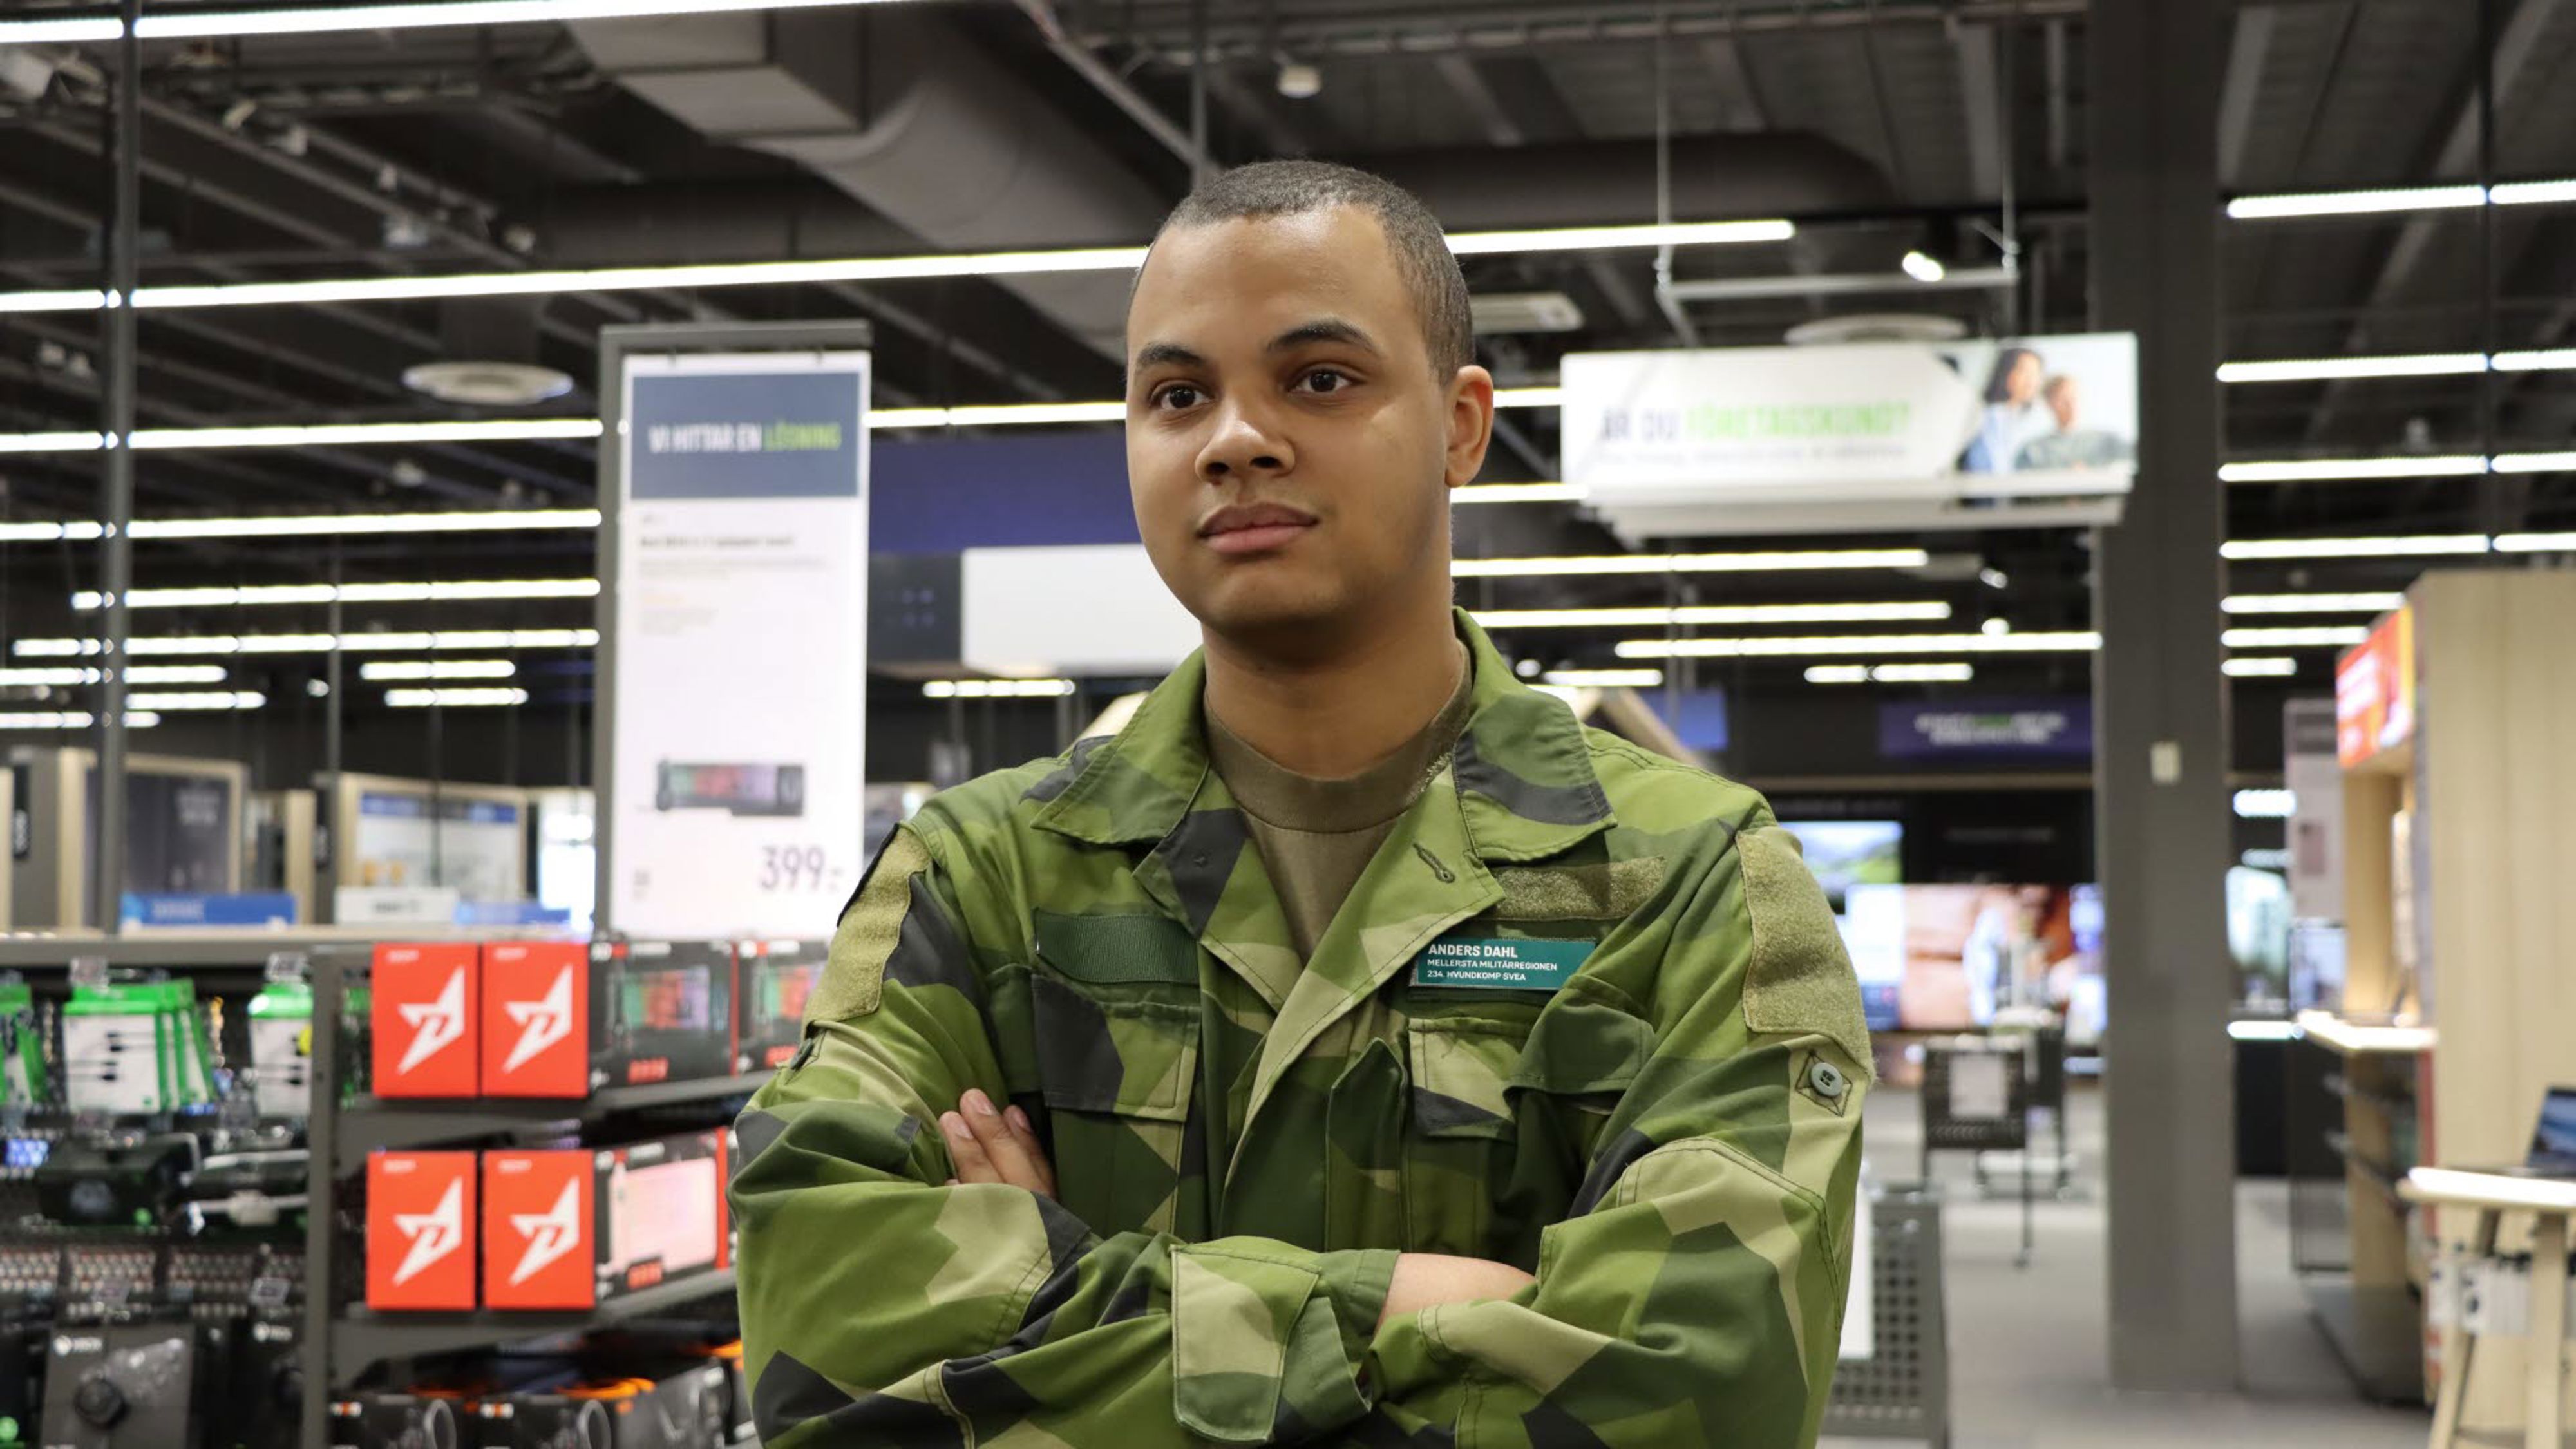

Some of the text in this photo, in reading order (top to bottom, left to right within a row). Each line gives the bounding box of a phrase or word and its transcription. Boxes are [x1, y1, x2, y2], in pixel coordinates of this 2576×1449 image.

[1428, 944, 1518, 958] ANDERS DAHL
[1427, 958, 1557, 971] MELLERSTA MILITÄRREGIONEN
[1427, 969, 1444, 978] 234.
[1446, 971, 1501, 980] HVUNDKOMP
